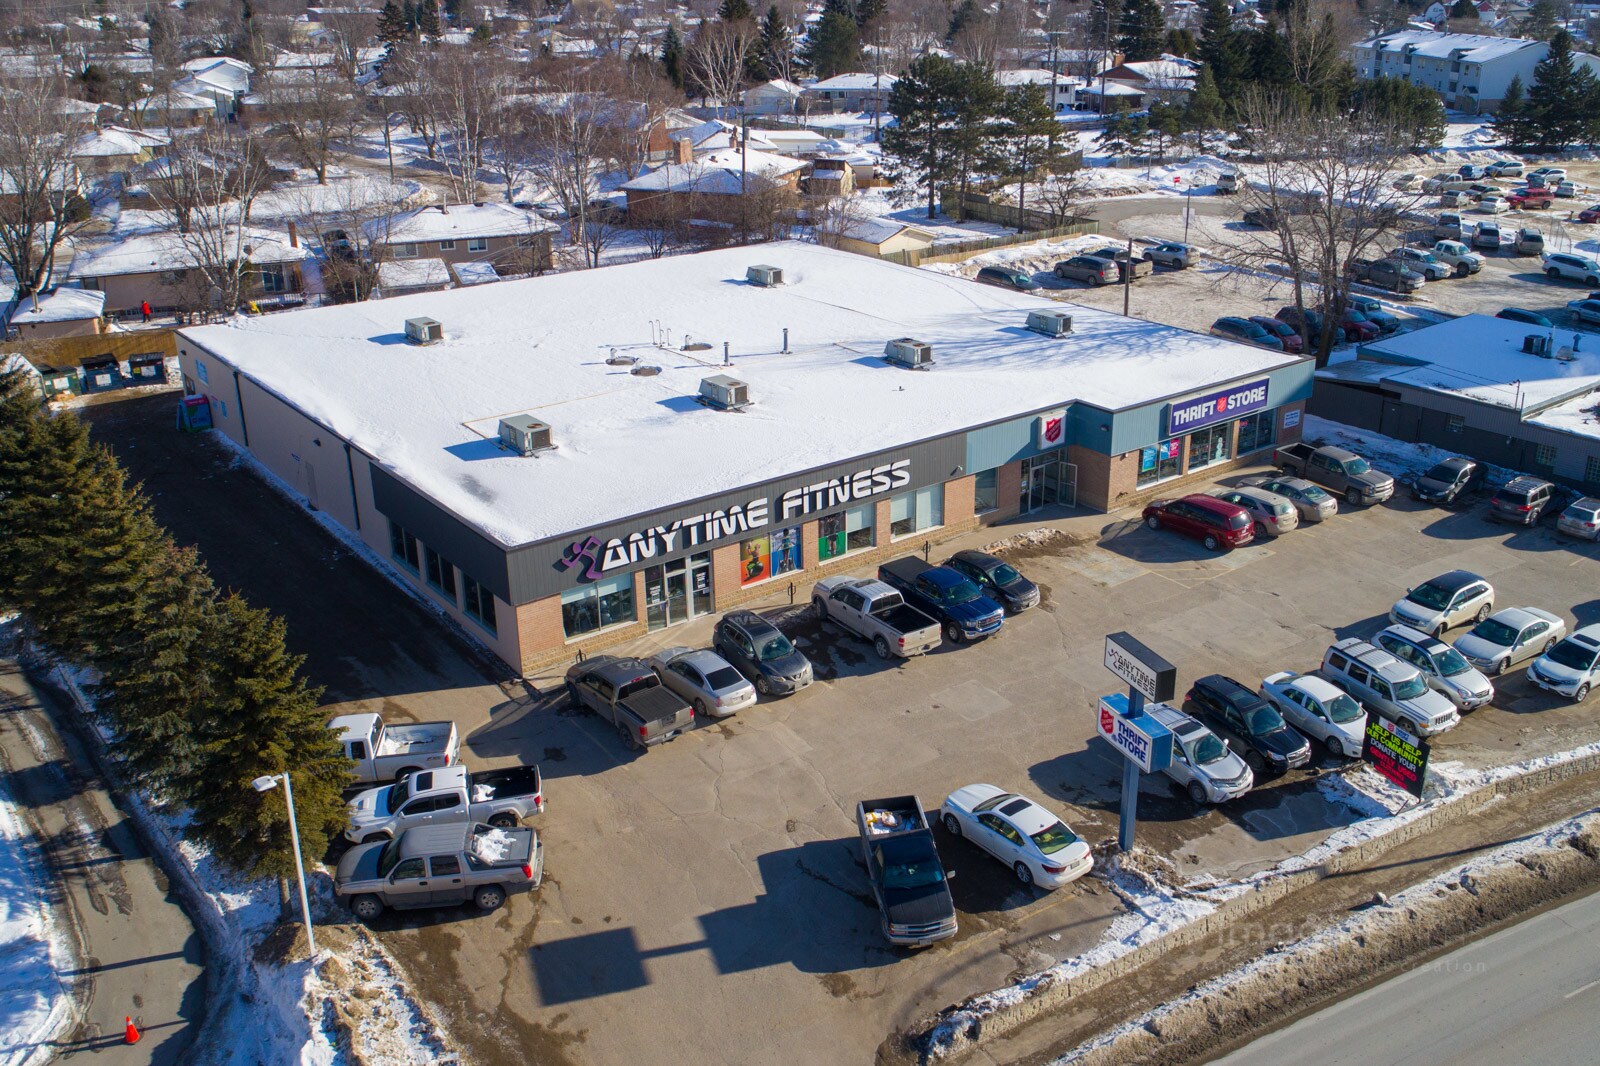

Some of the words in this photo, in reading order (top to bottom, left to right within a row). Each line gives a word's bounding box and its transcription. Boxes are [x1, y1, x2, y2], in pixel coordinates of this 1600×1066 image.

[1174, 400, 1216, 425] THRIFT
[1227, 386, 1266, 410] STORE
[601, 497, 768, 571] ANYTIME
[783, 459, 911, 519] FITNESS
[1118, 655, 1155, 688] ANYTIME
[1118, 664, 1155, 696] FITNESS
[1118, 720, 1148, 751] THRIFT
[1118, 733, 1146, 763] STORE
[1366, 727, 1379, 740] OUR
[1380, 736, 1424, 767] COMMUNITY
[1372, 722, 1389, 737] HELP
[1391, 735, 1401, 746] US
[1402, 742, 1422, 756] HELP
[1370, 738, 1396, 759] DONATE
[1399, 755, 1416, 773] YOUR
